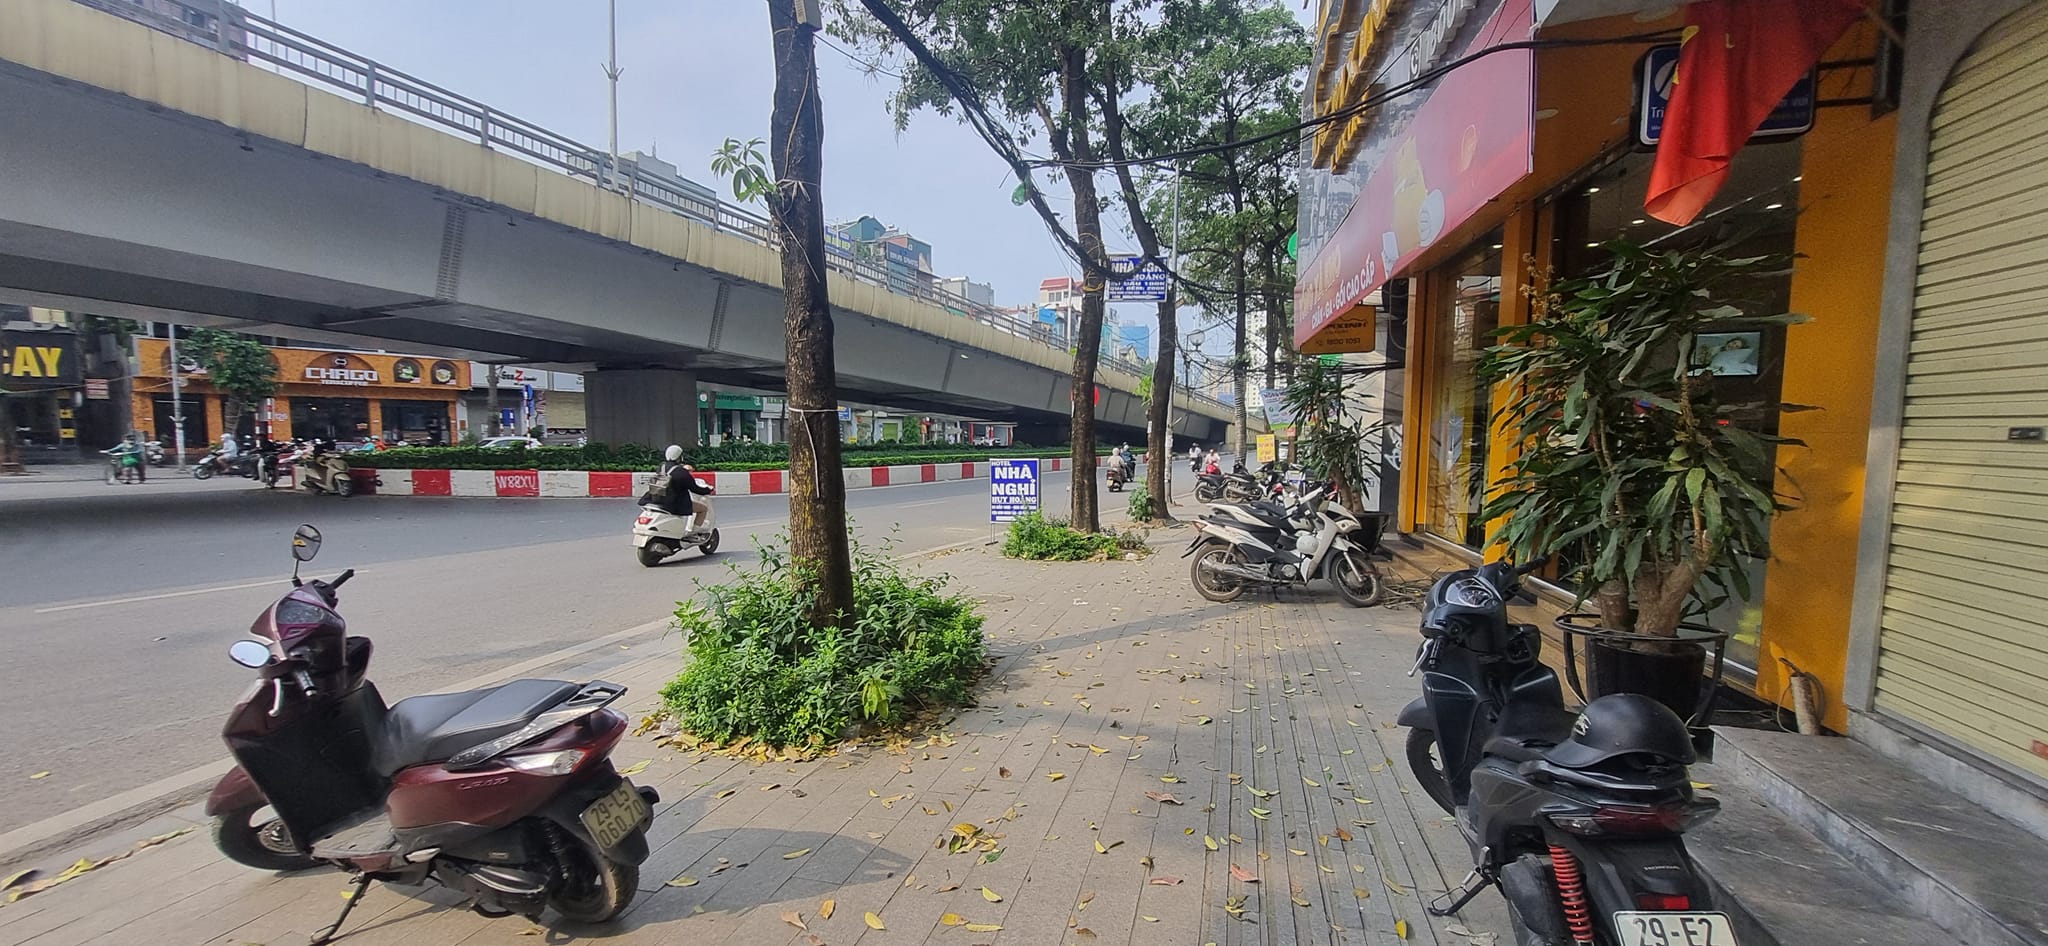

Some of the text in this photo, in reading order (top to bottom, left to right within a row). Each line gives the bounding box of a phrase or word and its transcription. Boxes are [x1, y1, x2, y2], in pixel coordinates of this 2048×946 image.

[1346, 275, 1360, 301] CAO
[1360, 254, 1375, 289] CẤP
[305, 367, 378, 381] CHAGO
[994, 464, 1033, 480] NHÀ
[992, 479, 1036, 496] NGHỈ
[991, 496, 1009, 504] HUY
[590, 788, 630, 826] 29-L5
[599, 799, 645, 847] 060.70
[1633, 917, 1712, 946] 29-E2
